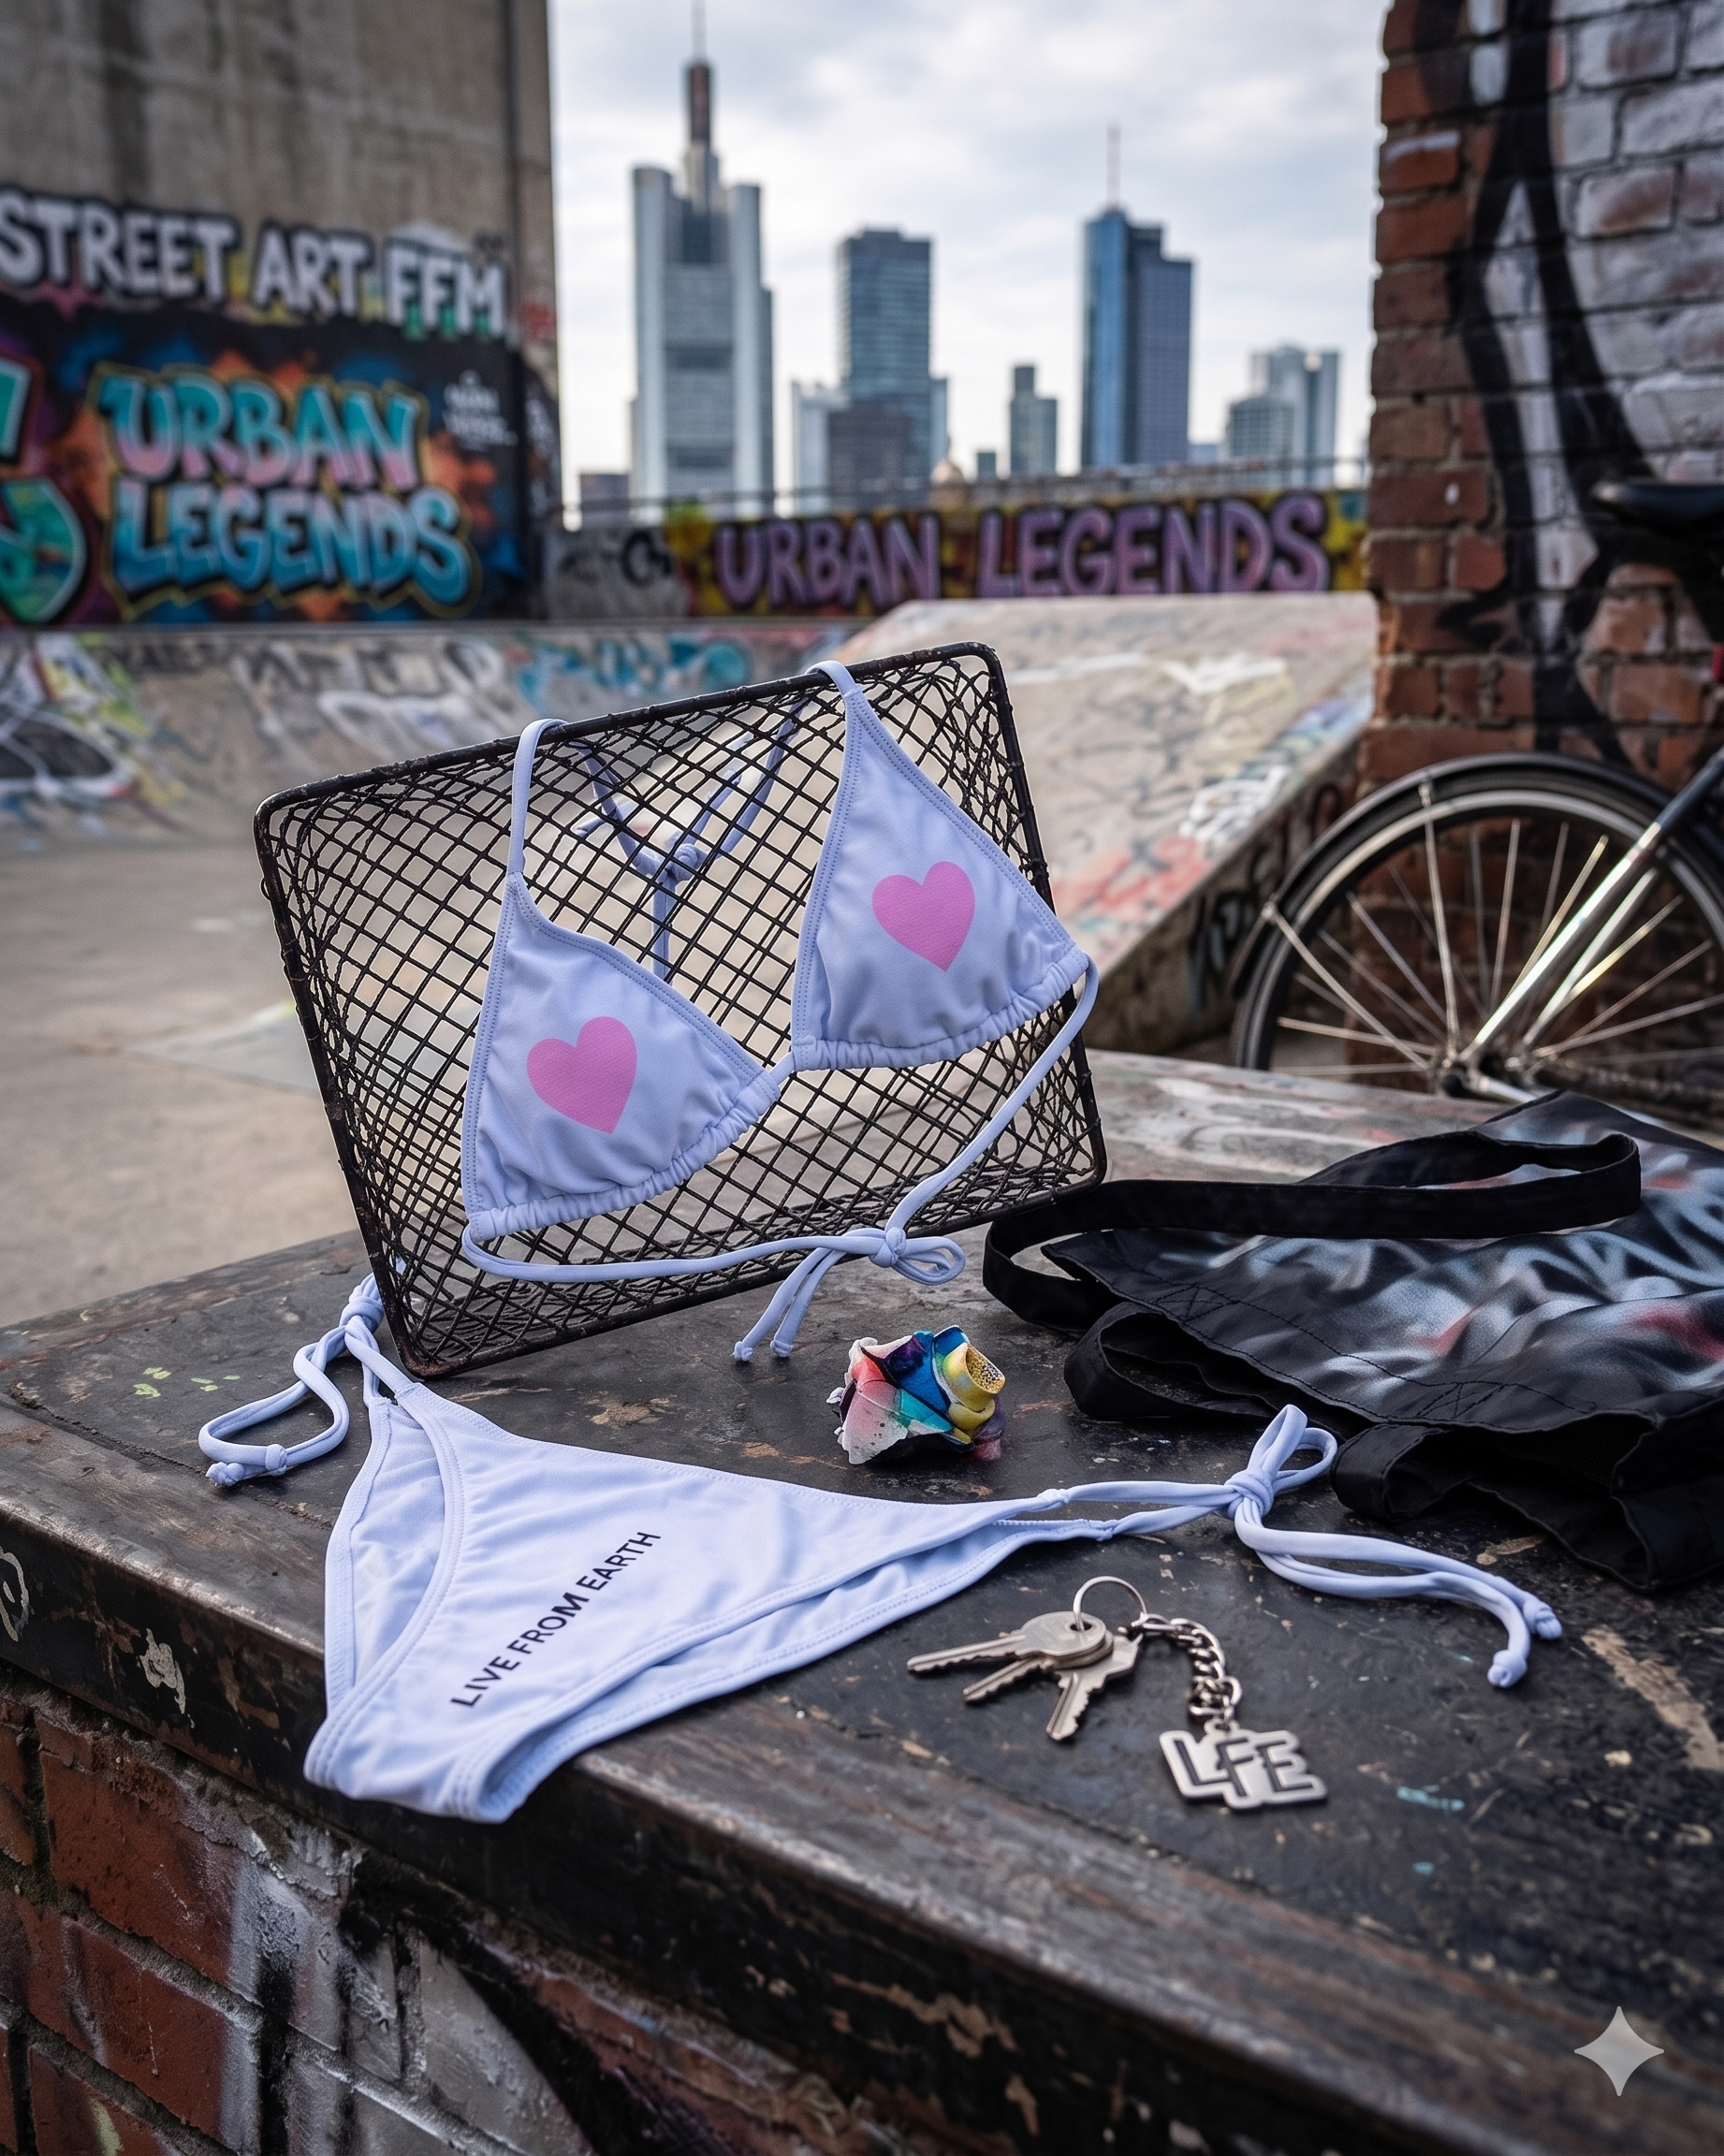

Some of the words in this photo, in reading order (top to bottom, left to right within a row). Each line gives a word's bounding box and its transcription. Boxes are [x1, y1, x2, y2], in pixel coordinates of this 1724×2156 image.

[0, 192, 236, 302] STREET
[254, 230, 369, 316] ART
[388, 245, 506, 335] FFM
[97, 375, 420, 490] URBAN
[112, 481, 469, 605] LEGENDS
[715, 515, 940, 605] URBAN
[978, 494, 1331, 598] LEGENDS
[450, 1655, 522, 1708] LIVE
[506, 1592, 591, 1654] FROM
[576, 1532, 662, 1591] EARTH
